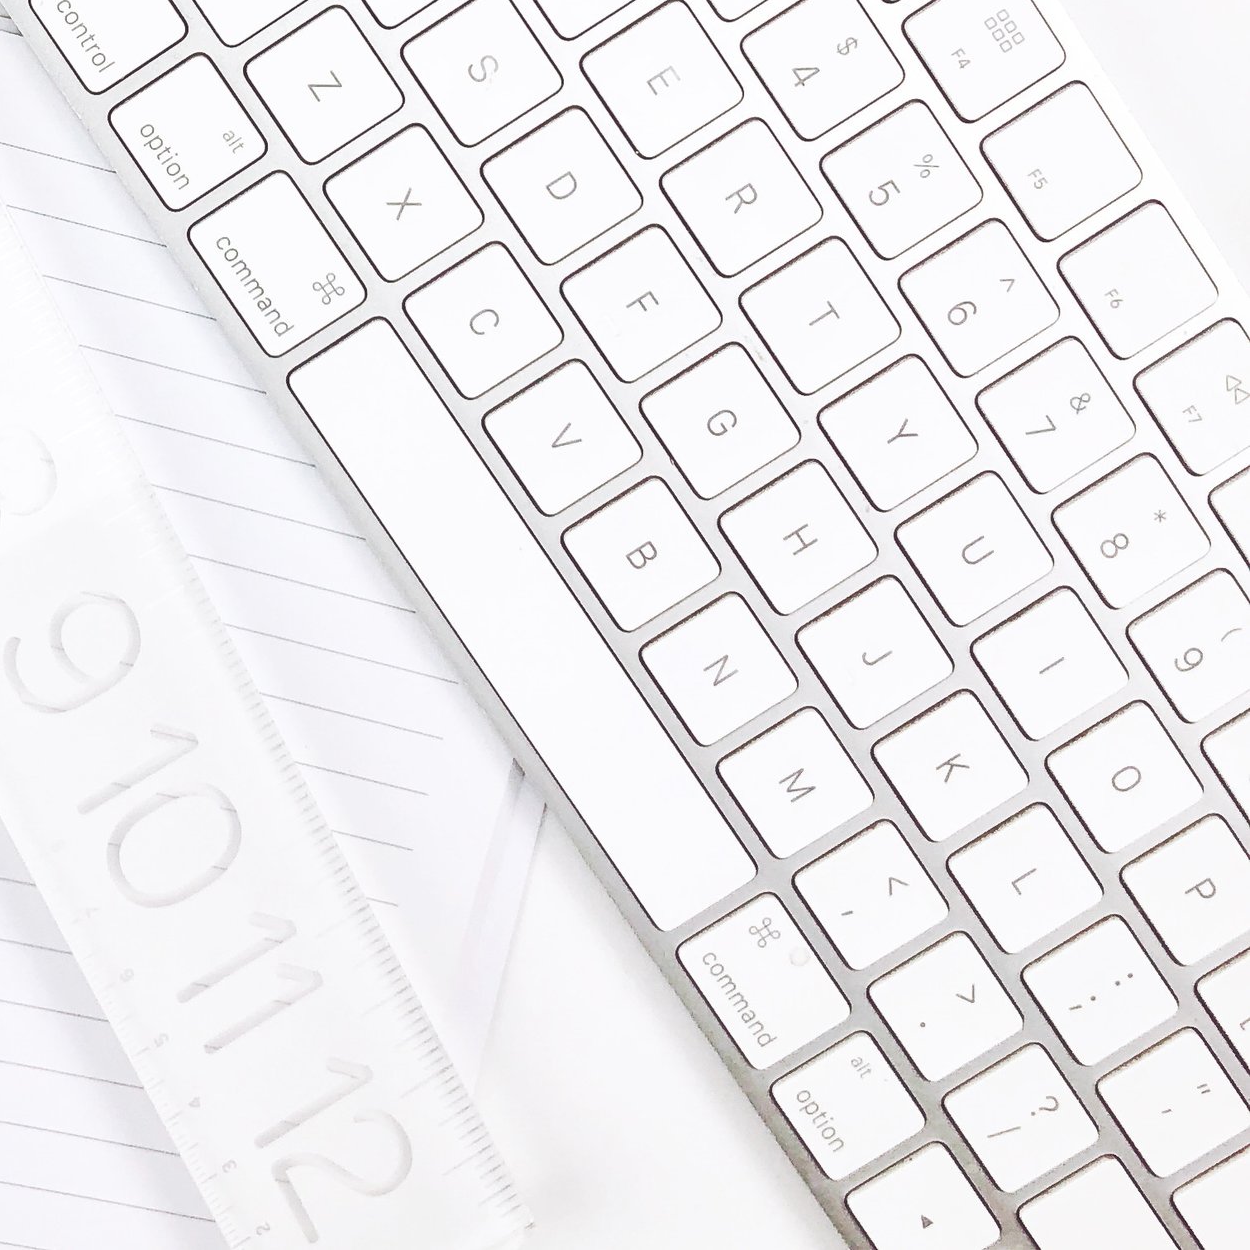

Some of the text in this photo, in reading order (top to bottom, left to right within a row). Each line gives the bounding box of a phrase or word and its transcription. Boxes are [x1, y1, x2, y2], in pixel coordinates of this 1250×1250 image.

[466, 54, 500, 84] S
[950, 46, 972, 70] F4
[306, 69, 344, 104] Z
[645, 64, 682, 97] E
[791, 65, 822, 88] 4
[139, 123, 190, 191] option
[221, 129, 245, 155] alt
[544, 169, 579, 202] D
[867, 178, 902, 208] 5
[1026, 167, 1049, 191] F5
[384, 186, 424, 222] X
[723, 181, 759, 216] R
[215, 235, 295, 338] command
[624, 289, 661, 313] F
[1103, 287, 1125, 310] F6
[468, 307, 501, 337] C
[807, 299, 842, 328] T
[946, 299, 979, 327] 6
[705, 408, 739, 438] G
[1024, 413, 1058, 437] 7
[1181, 403, 1204, 424] F7
[550, 421, 584, 450] V
[885, 417, 920, 446] Y
[781, 522, 820, 557] H
[960, 534, 996, 567] U
[1099, 531, 1131, 560] 8
[624, 539, 659, 571] B
[3, 591, 141, 713] 9
[860, 649, 894, 668] J
[1173, 646, 1205, 673] 9
[702, 653, 740, 688] N
[934, 752, 972, 785] K
[1110, 764, 1143, 794] O
[777, 767, 818, 804] M
[77, 722, 242, 908] 10
[1010, 866, 1039, 897] L
[1183, 876, 1218, 901] P
[176, 911, 323, 1054] 11
[702, 951, 778, 1048] command
[850, 1057, 872, 1079] alt
[796, 1089, 845, 1153] option
[254, 1057, 413, 1243] 12
